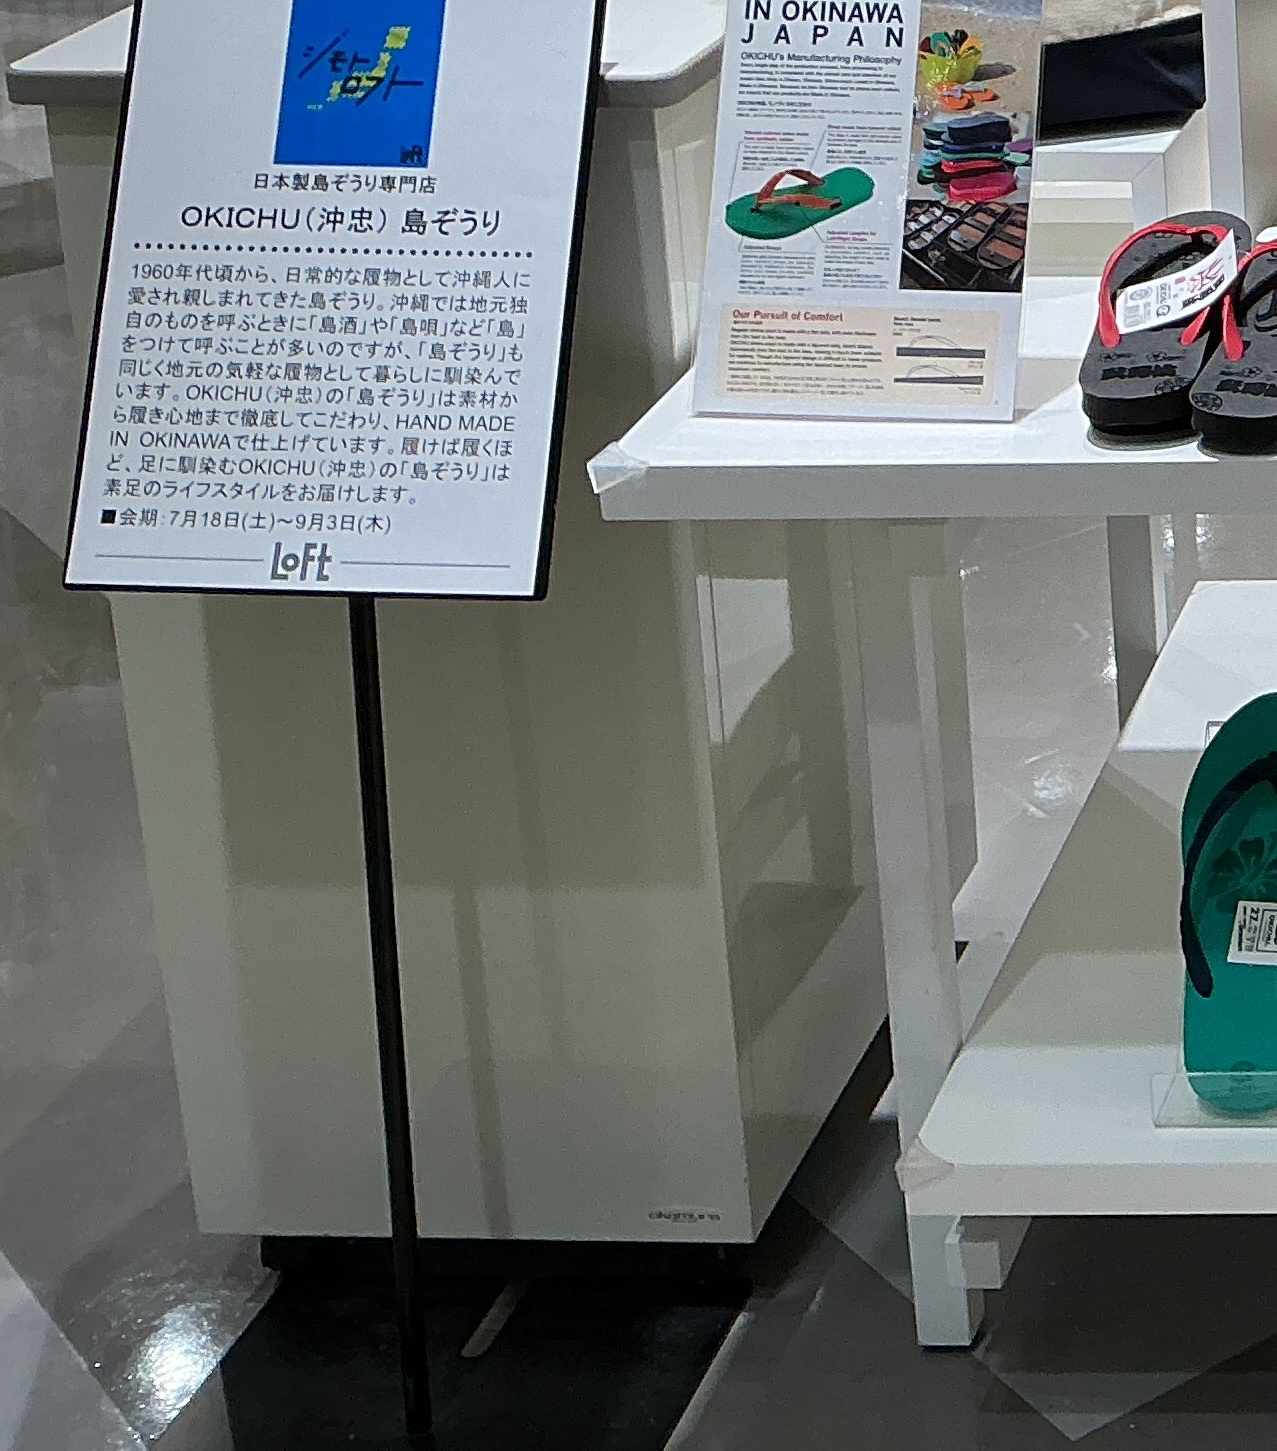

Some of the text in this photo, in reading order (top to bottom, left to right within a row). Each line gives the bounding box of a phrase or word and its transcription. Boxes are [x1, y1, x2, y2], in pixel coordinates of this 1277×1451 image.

[744, 0, 904, 24] IN OKINAWA
[740, 23, 904, 48] JAPAN
[852, 55, 903, 66] Philosophy
[339, 65, 425, 107] ロフト
[253, 172, 437, 195] 日本製島ぞうり専門店
[181, 205, 501, 237] OKICHU（沖忠） 島ぞうり
[732, 308, 844, 322] Our Pursuit of Comfort
[457, 414, 517, 432] MADE
[109, 430, 129, 447] IN
[102, 477, 417, 506] 素足のライフスタイルをお届けします。
